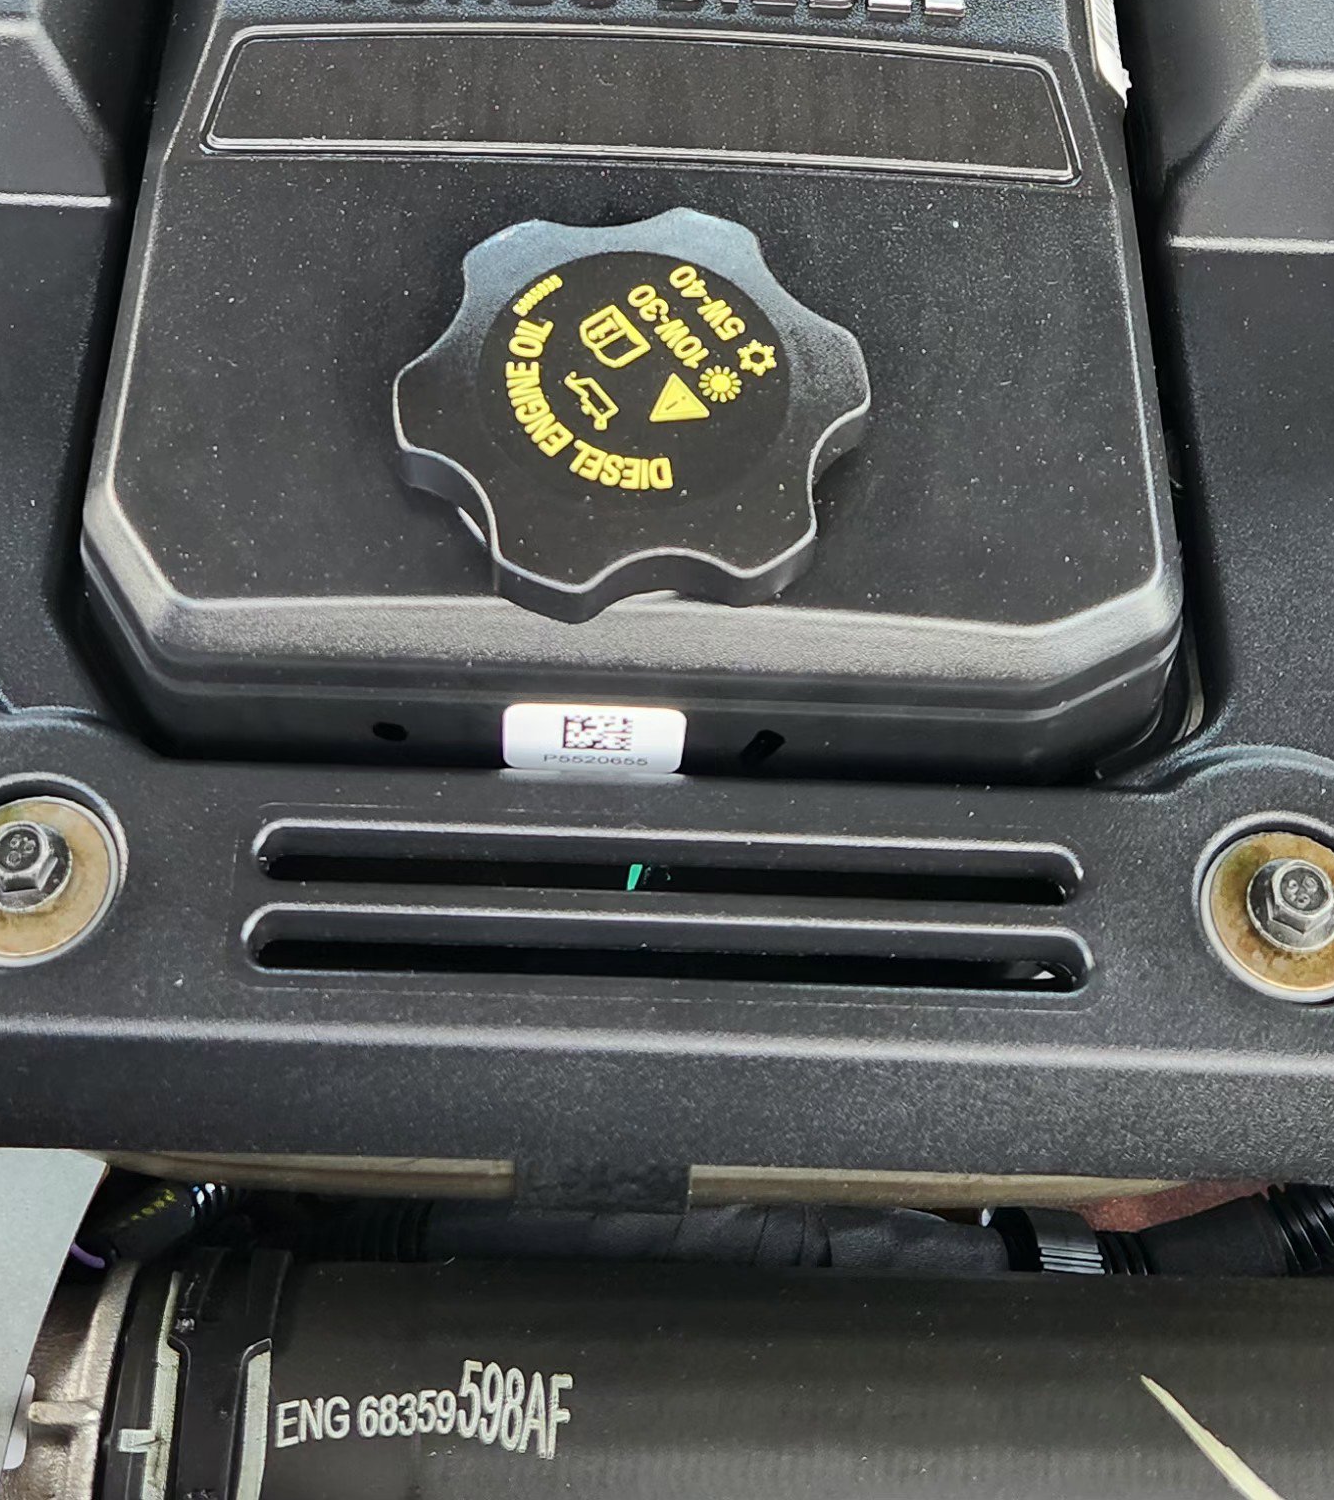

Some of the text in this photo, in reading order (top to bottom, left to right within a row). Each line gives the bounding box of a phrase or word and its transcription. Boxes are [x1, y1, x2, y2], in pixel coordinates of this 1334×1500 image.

[507, 319, 556, 360] OIL
[626, 284, 711, 371] 10W-30
[668, 264, 747, 342] 5W-40
[504, 360, 576, 459] ENGINE
[568, 438, 675, 491] DIESEL
[274, 1358, 575, 1462] ENG 68359598AF
